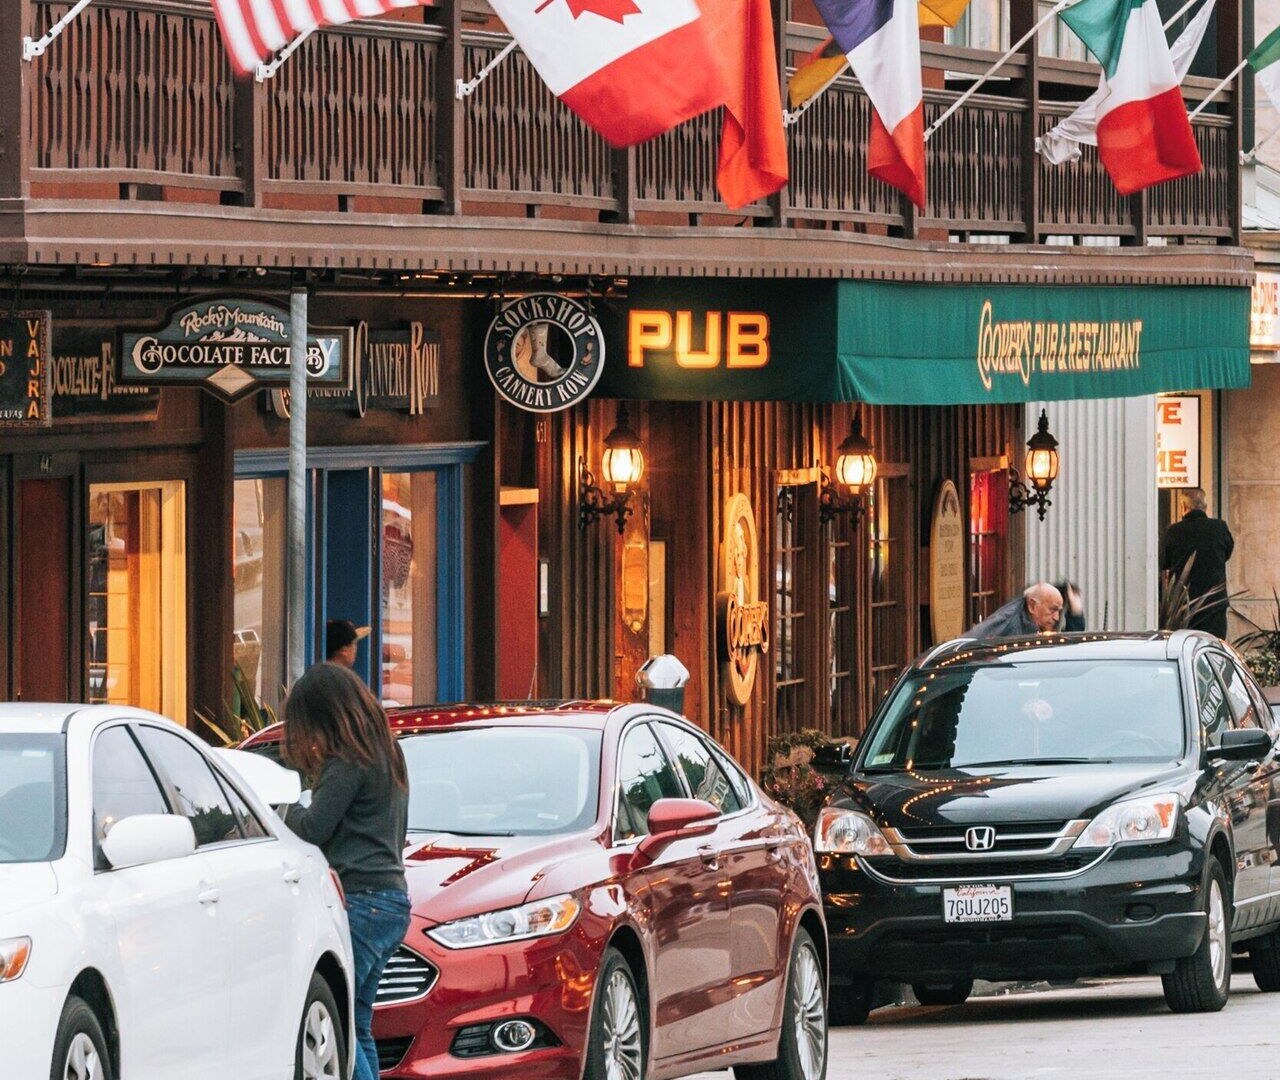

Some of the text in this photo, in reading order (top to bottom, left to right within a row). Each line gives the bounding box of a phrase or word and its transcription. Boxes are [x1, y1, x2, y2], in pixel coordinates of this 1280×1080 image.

[180, 304, 288, 338] Rocky Mountain
[628, 309, 771, 369] PUB
[131, 336, 244, 374] CHOCOLATE
[250, 337, 339, 377] FACTRY
[1032, 323, 1059, 371] PUB
[1058, 323, 1068, 370] &
[1068, 321, 1143, 370] RESTAURANT
[27, 320, 40, 419] VAJRA
[496, 366, 589, 406] CANNERY ROW
[947, 897, 1009, 916] 7GUJ205
